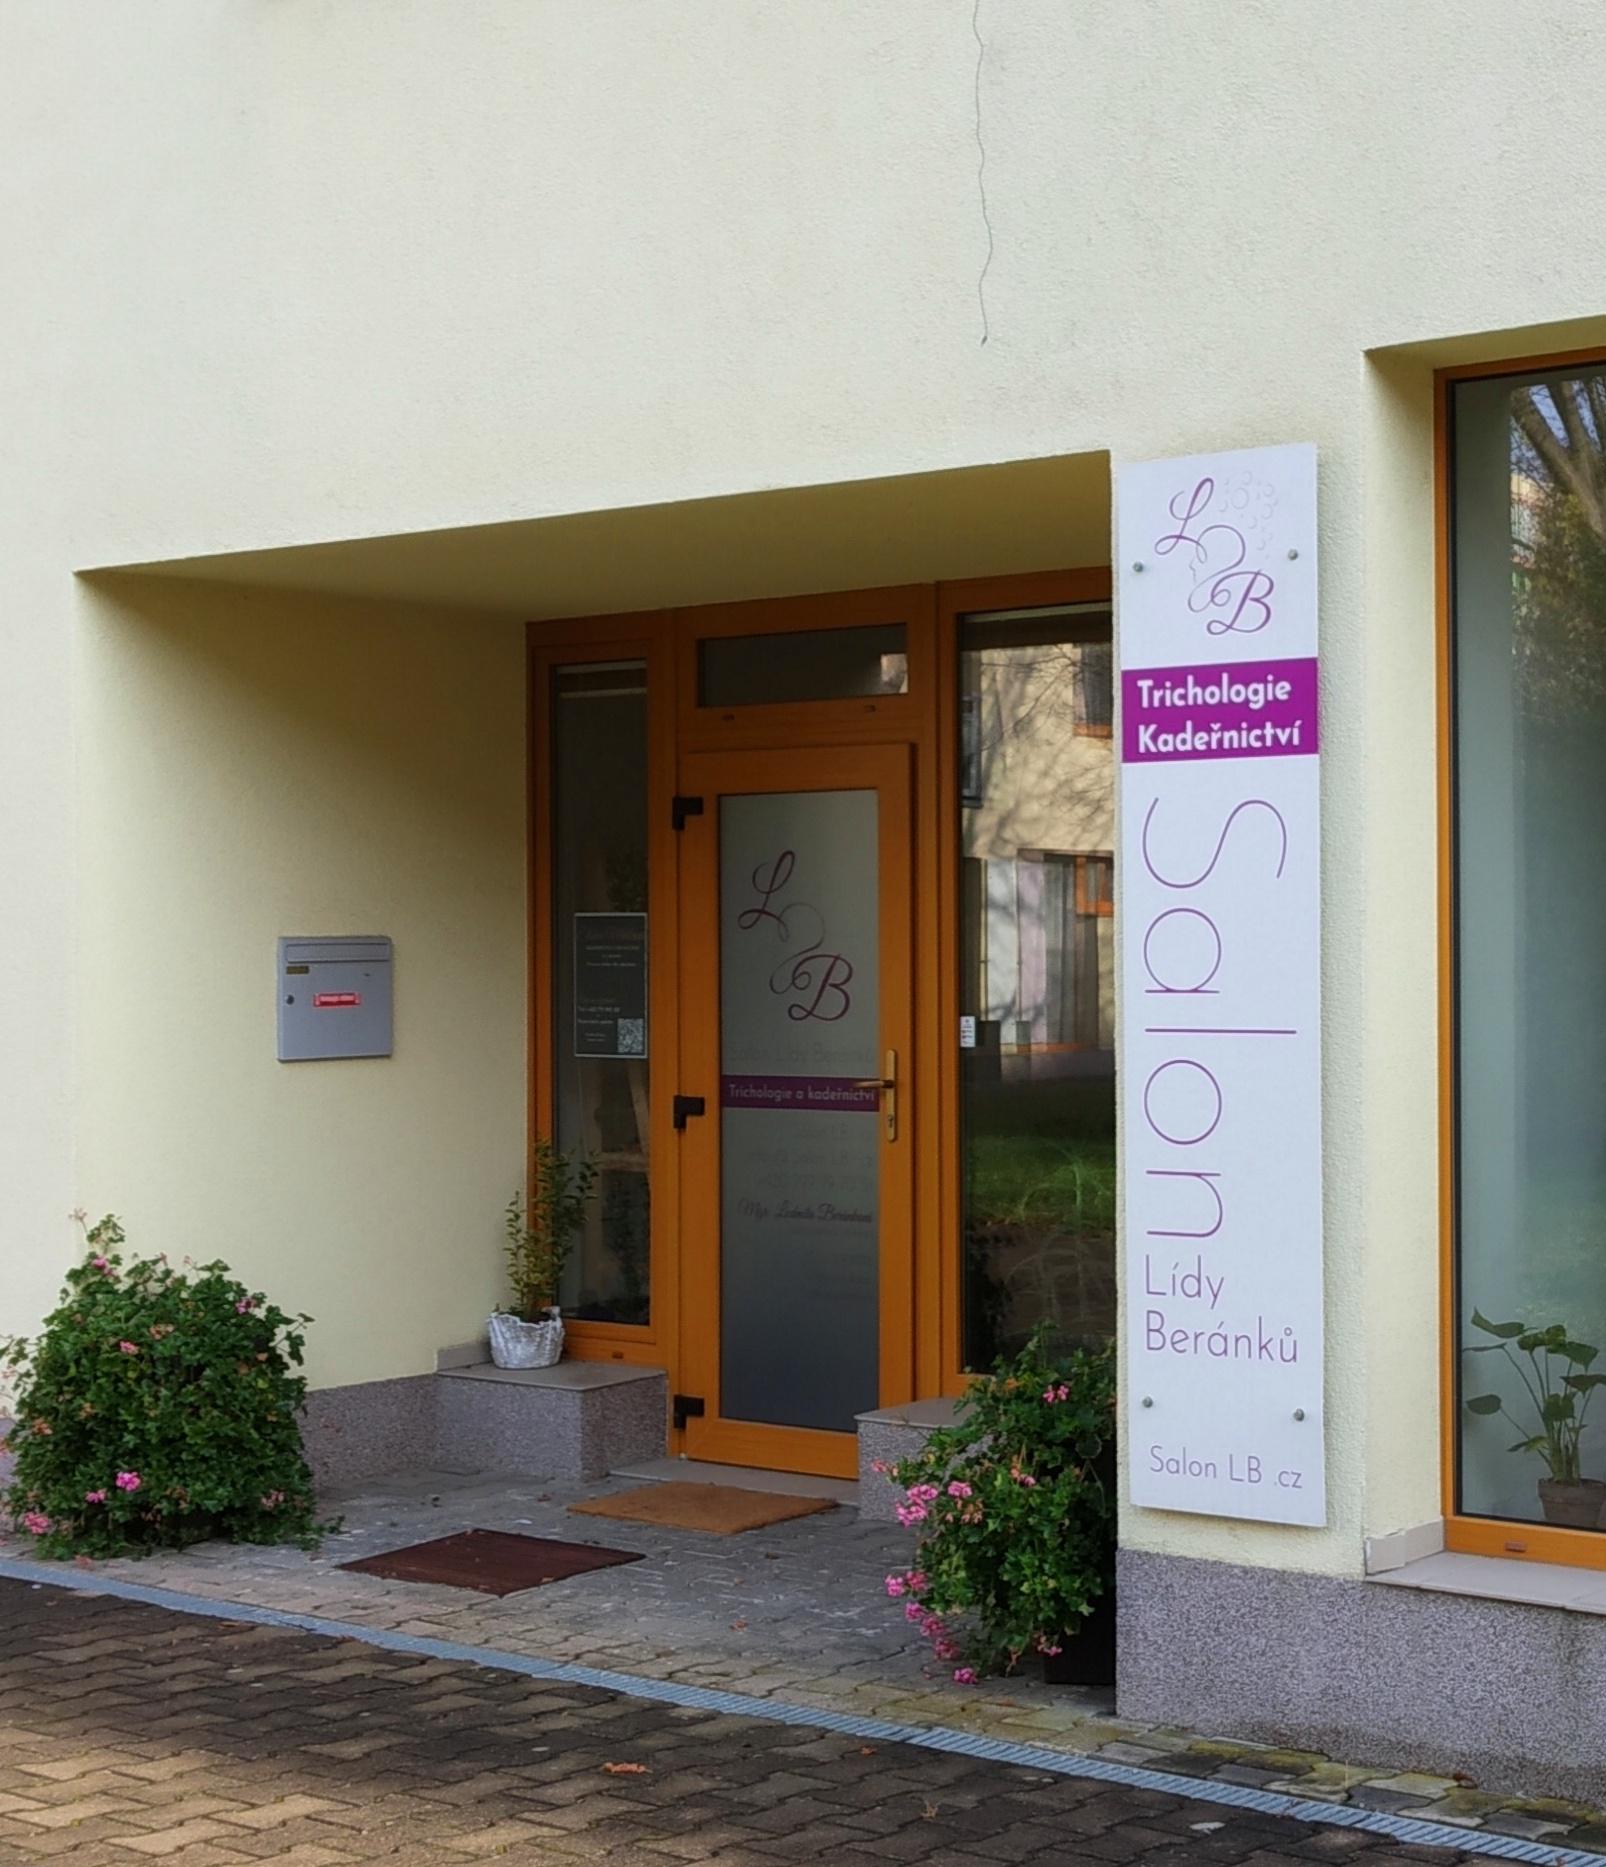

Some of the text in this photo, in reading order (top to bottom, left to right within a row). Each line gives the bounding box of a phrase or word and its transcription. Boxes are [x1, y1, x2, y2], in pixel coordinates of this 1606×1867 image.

[1137, 672, 1292, 711] Trichologie
[1138, 720, 1303, 754] Kadeřnictví
[1142, 797, 1297, 1238] Salon
[729, 1084, 792, 1101] Trichologie
[1145, 1254, 1225, 1310] Lídy
[1145, 1310, 1299, 1363] Beránků
[1150, 1445, 1217, 1479] Salon
[1229, 1454, 1263, 1484] LB
